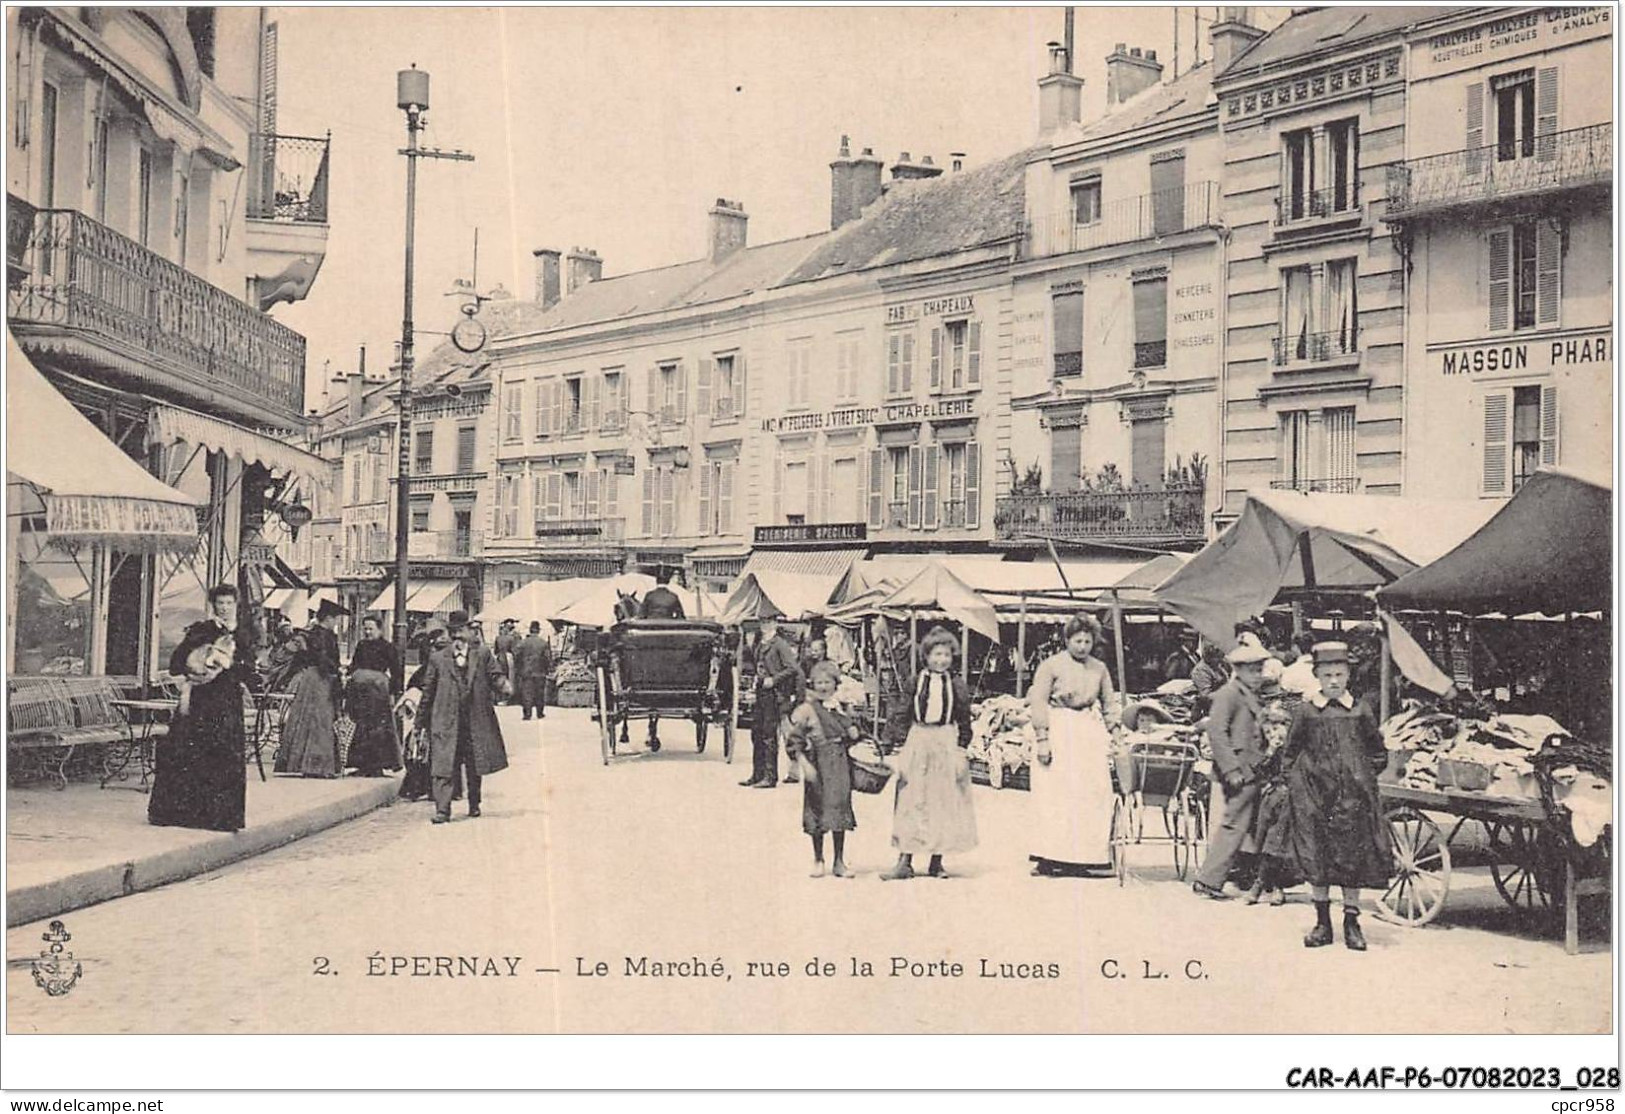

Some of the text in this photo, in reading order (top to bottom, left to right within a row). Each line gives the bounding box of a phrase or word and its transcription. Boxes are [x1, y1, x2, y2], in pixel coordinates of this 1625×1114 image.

[1489, 15, 1538, 36] ANALYSES
[1490, 29, 1538, 49] CHIMIQUES
[1176, 283, 1212, 298] MERCERIE
[923, 295, 974, 316] CHAPEAUX
[1175, 308, 1215, 324] BONNETERIE
[1442, 337, 1613, 375] MASSON PHAR
[887, 398, 974, 421] CHAPELLERIE
[758, 525, 858, 541] CHEMISERIE SPECIALE
